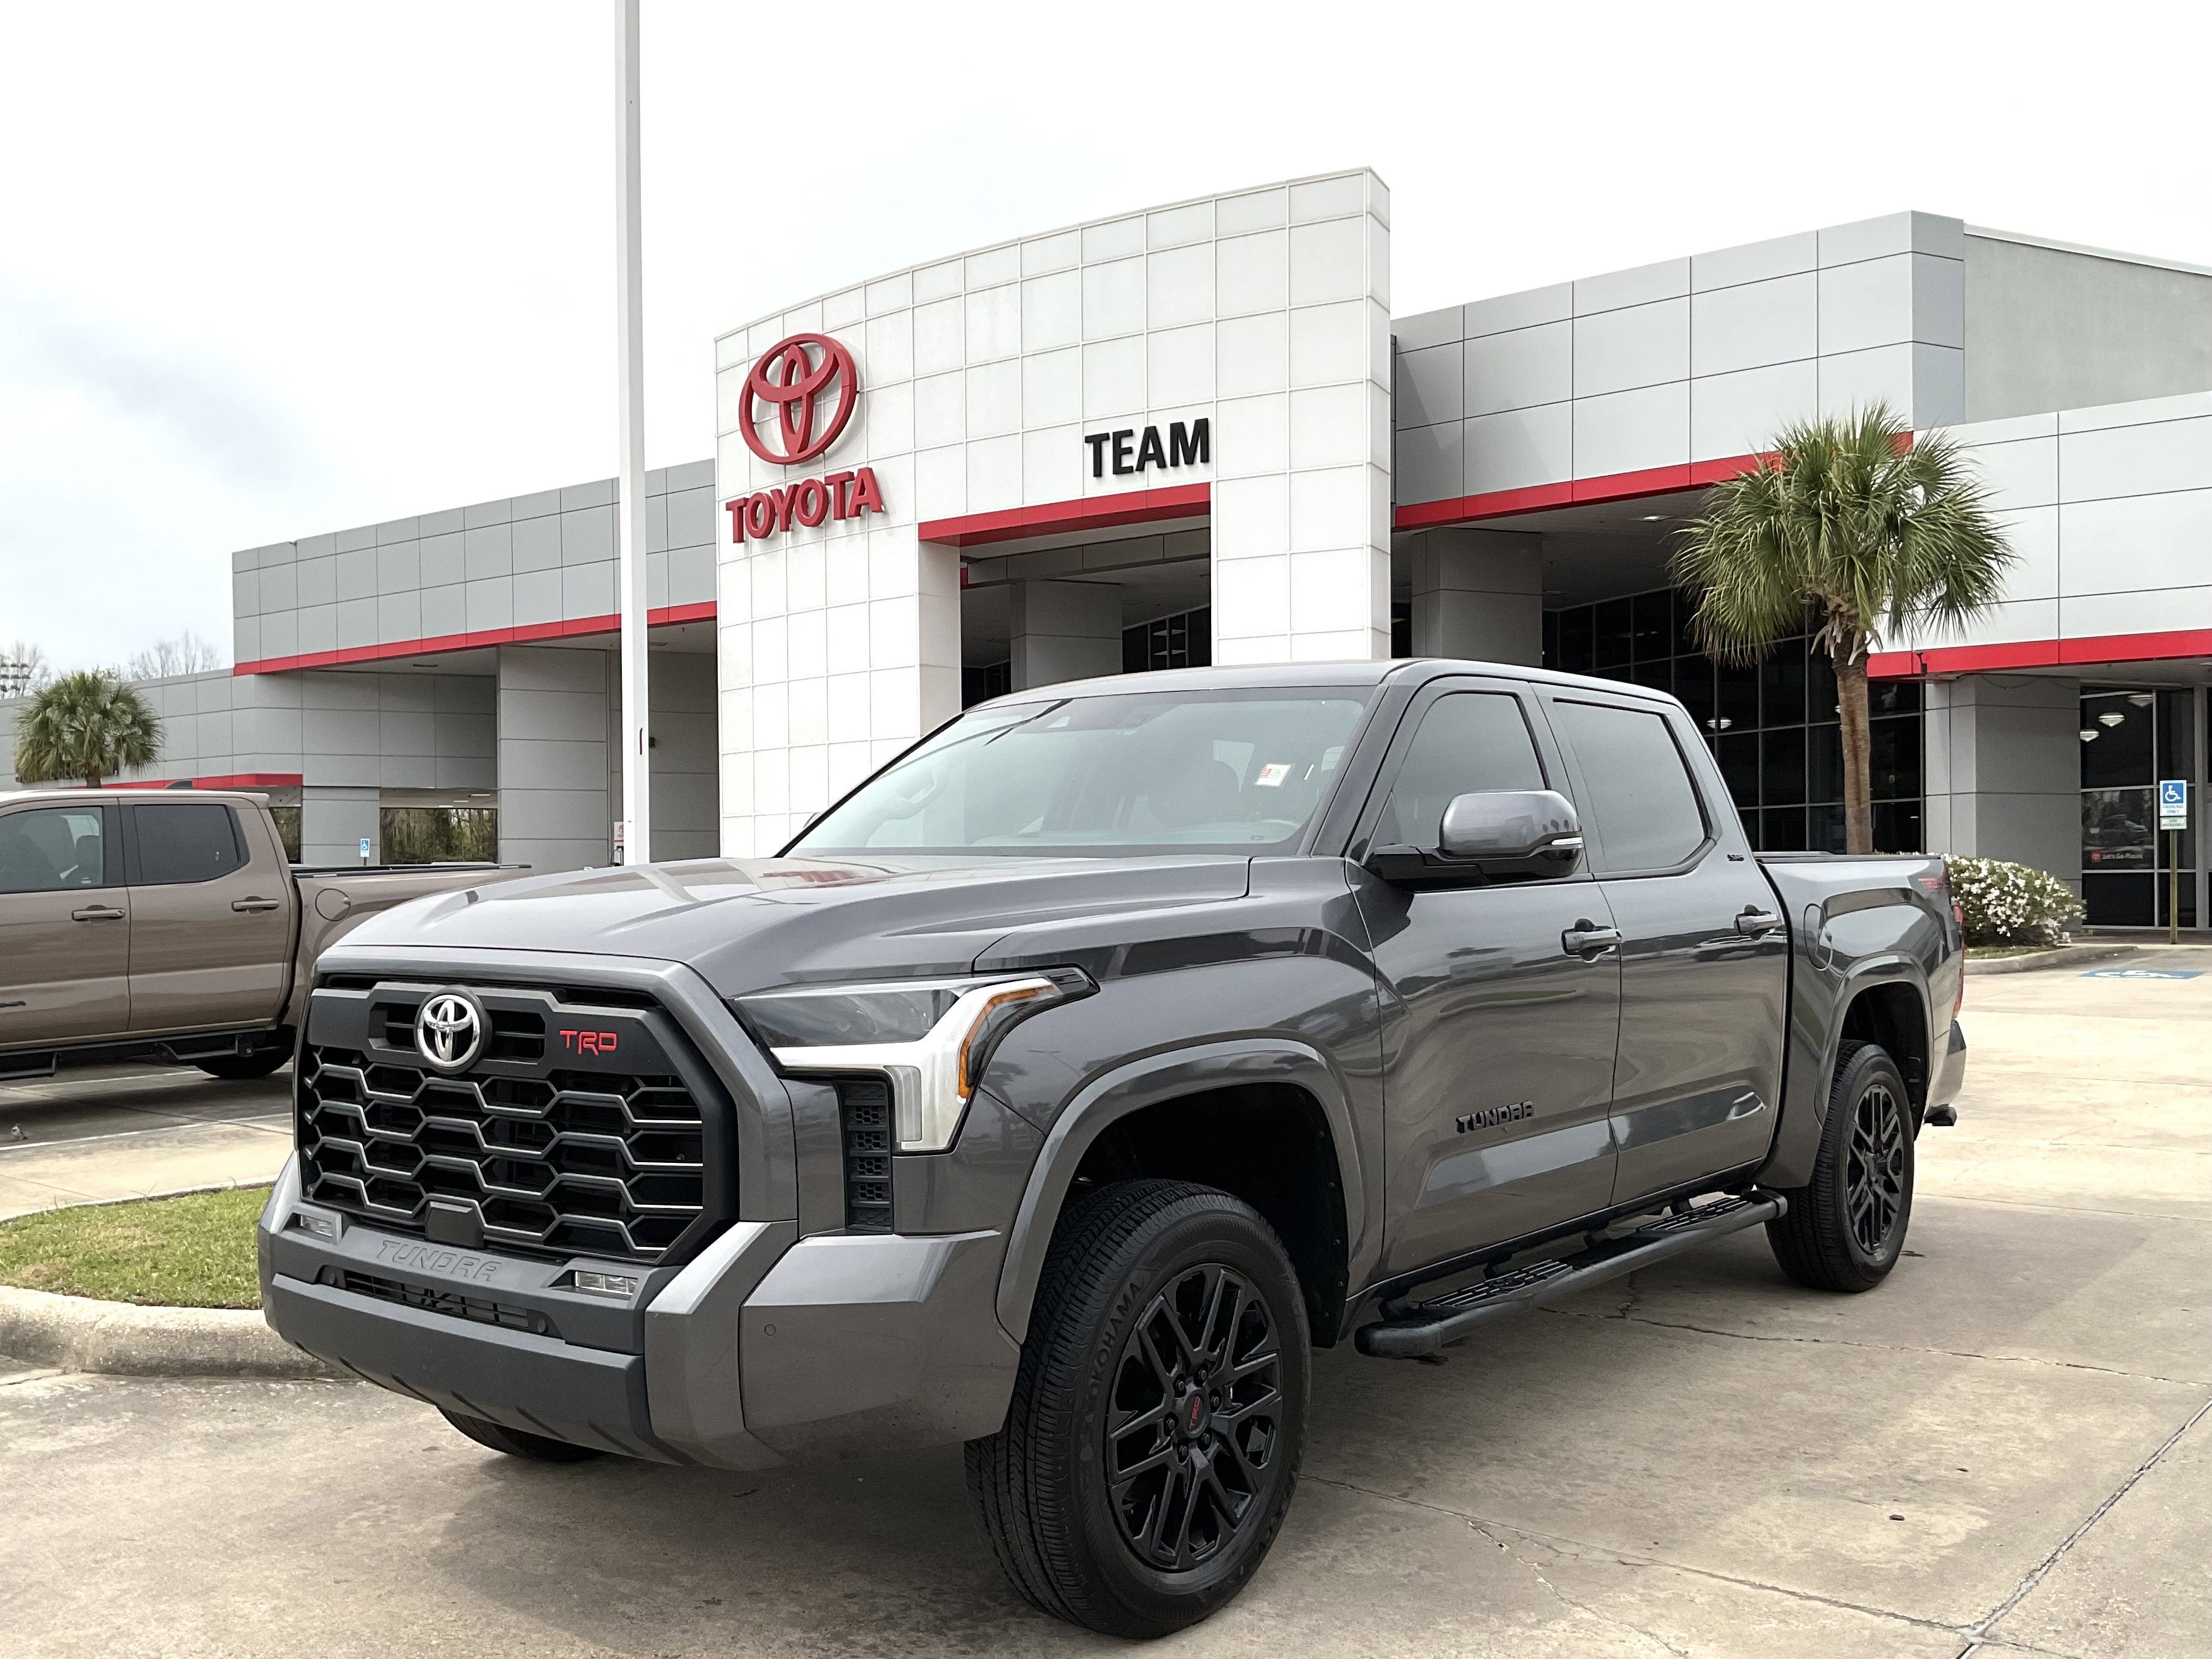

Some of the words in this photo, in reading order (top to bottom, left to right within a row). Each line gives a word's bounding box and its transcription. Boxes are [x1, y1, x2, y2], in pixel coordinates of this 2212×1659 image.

[1084, 418, 1209, 477] TEAM
[726, 467, 885, 544] TOYOTA
[559, 1030, 617, 1056] TRD
[1456, 1100, 1534, 1133] TUNDRA
[377, 1240, 502, 1282] TUNDRA
[1083, 1282, 1141, 1410] OKOHAMA
